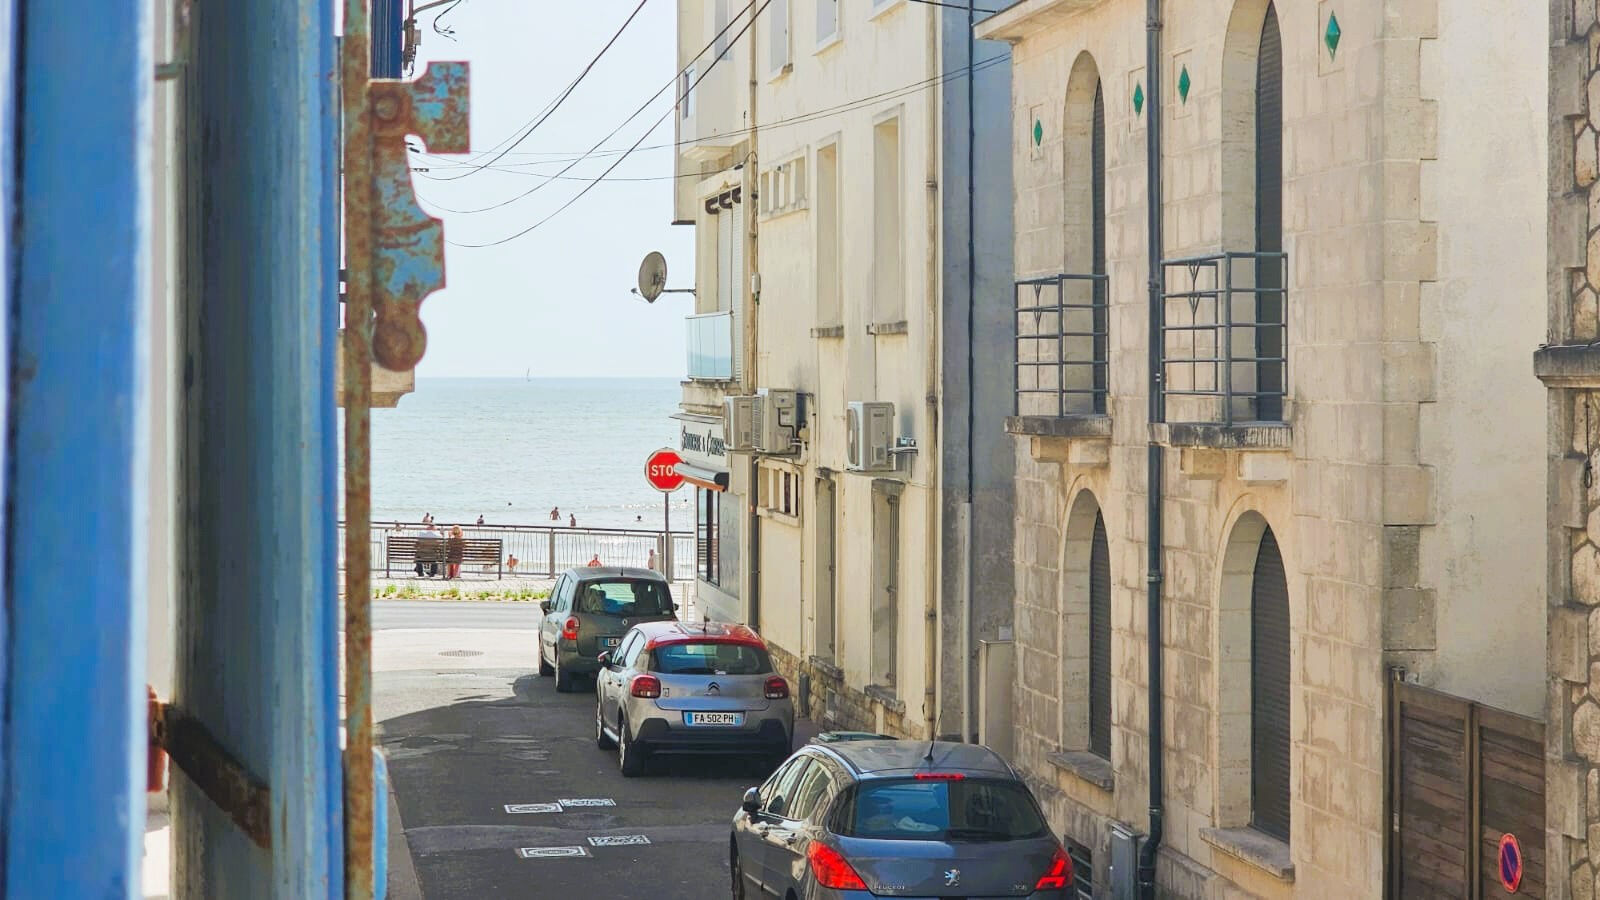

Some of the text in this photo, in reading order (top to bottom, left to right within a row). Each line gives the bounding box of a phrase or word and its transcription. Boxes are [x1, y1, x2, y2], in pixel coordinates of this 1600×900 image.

[651, 464, 678, 477] STO
[694, 713, 734, 723] FA 502 PH
